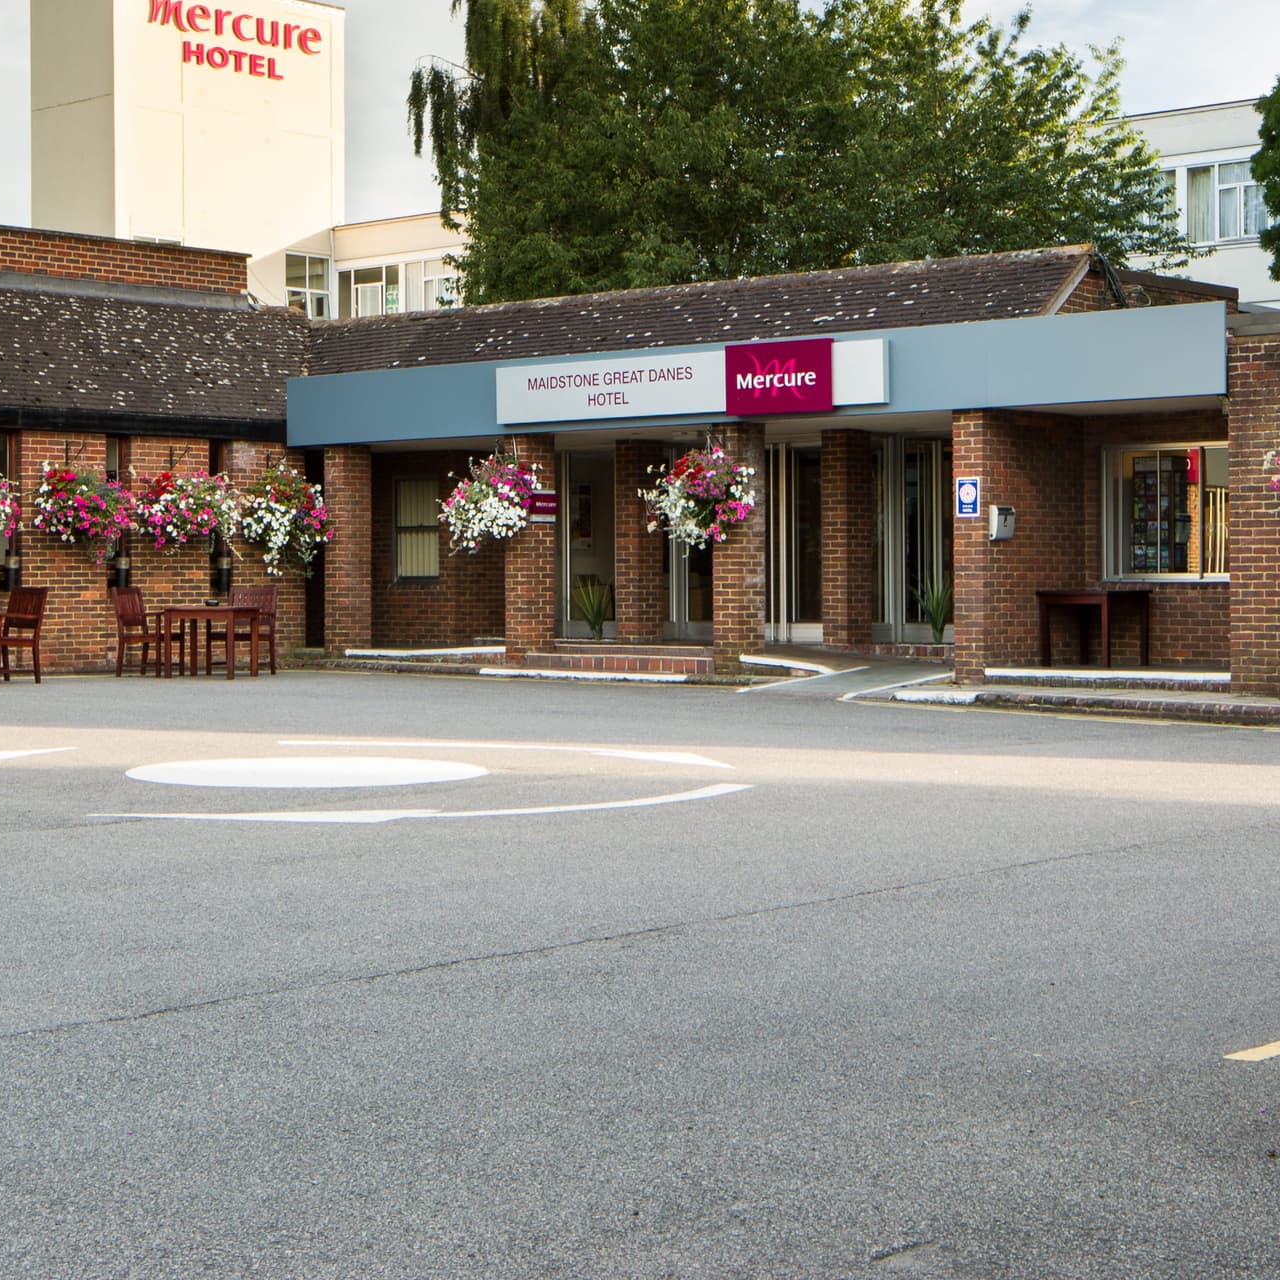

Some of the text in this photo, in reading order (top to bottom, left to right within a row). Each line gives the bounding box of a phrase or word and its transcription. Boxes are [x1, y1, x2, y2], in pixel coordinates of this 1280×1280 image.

[182, 41, 284, 80] HOTEL
[527, 366, 693, 391] MAIDSTONE GREAT DANES
[736, 371, 817, 390] Mercure
[587, 392, 629, 407] HOTEL
